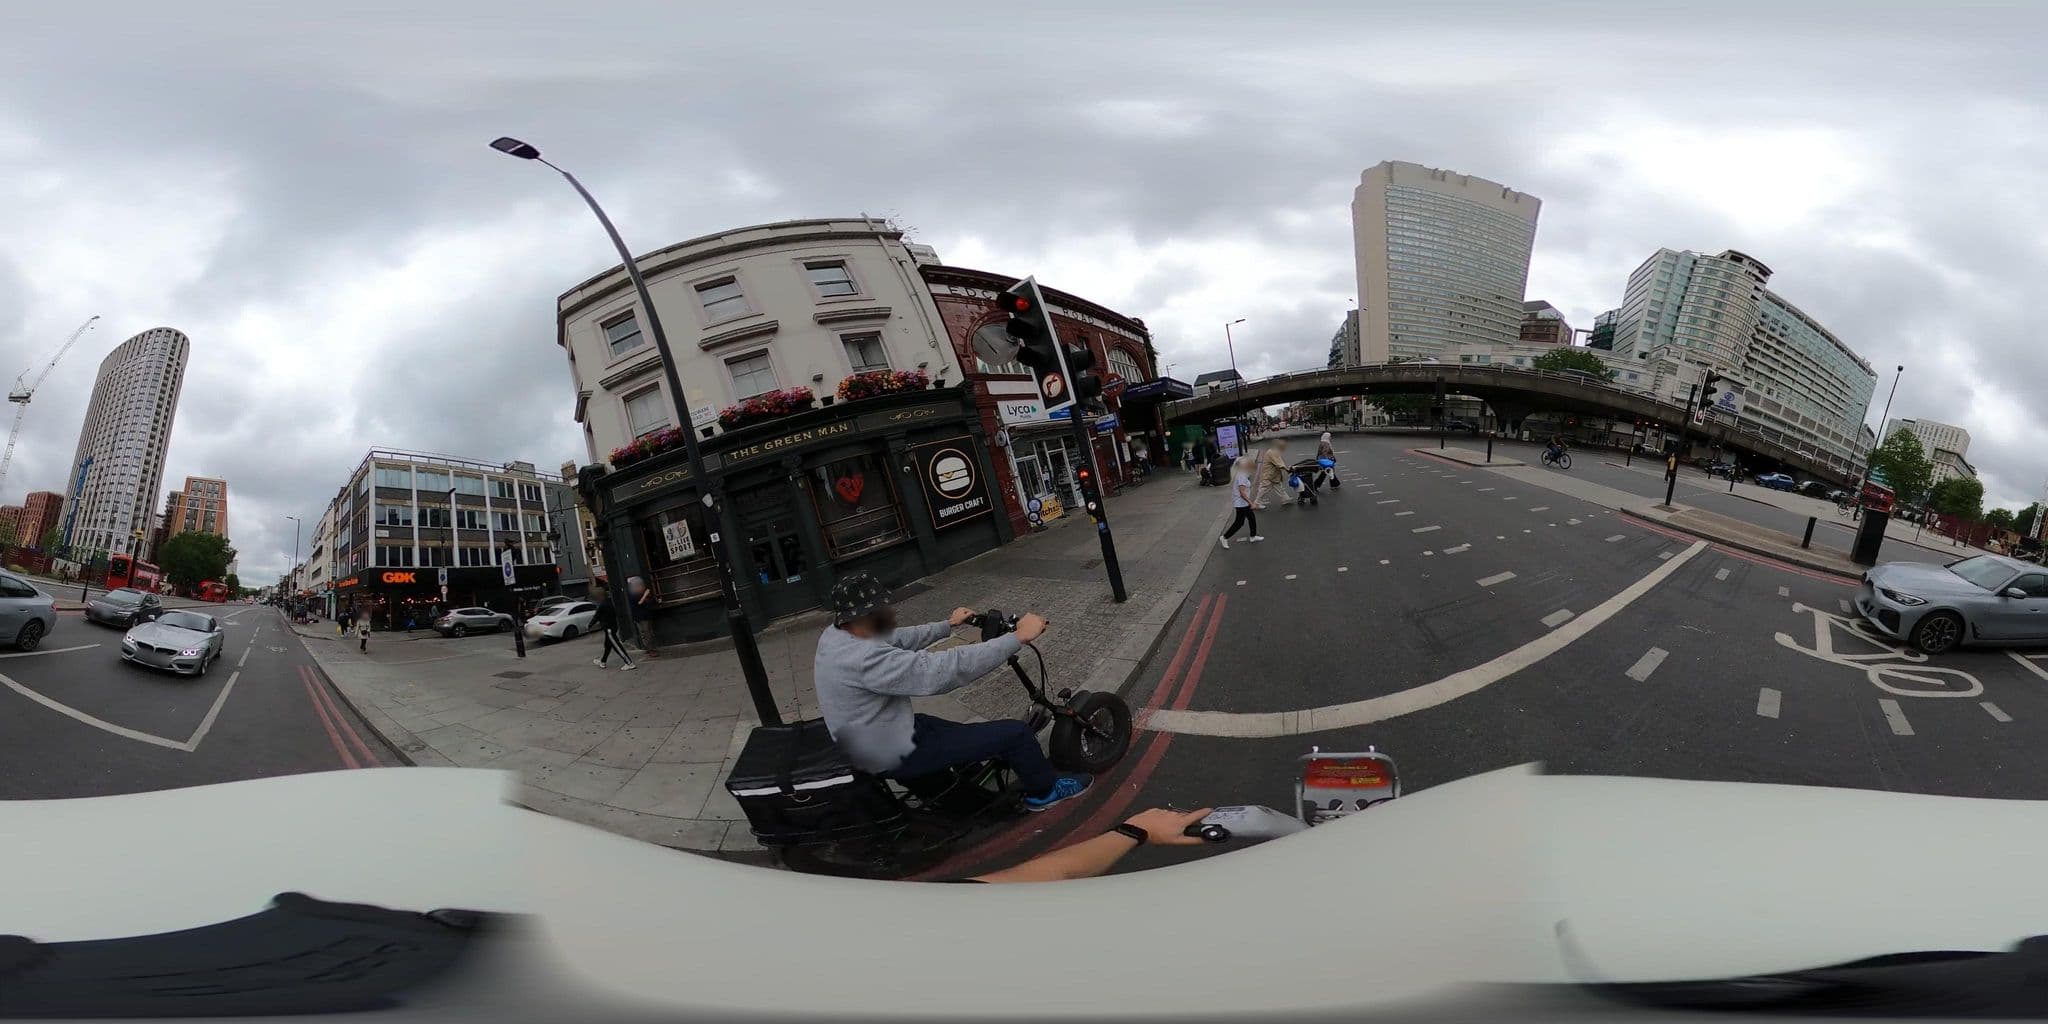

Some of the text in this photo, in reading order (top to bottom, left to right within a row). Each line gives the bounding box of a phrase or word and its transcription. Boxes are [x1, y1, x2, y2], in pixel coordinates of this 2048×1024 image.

[1006, 404, 1031, 416] Lyca
[731, 423, 848, 459] THE GREEN MAN
[939, 496, 983, 518] BURGER CRAFT
[382, 572, 416, 583] GDK
